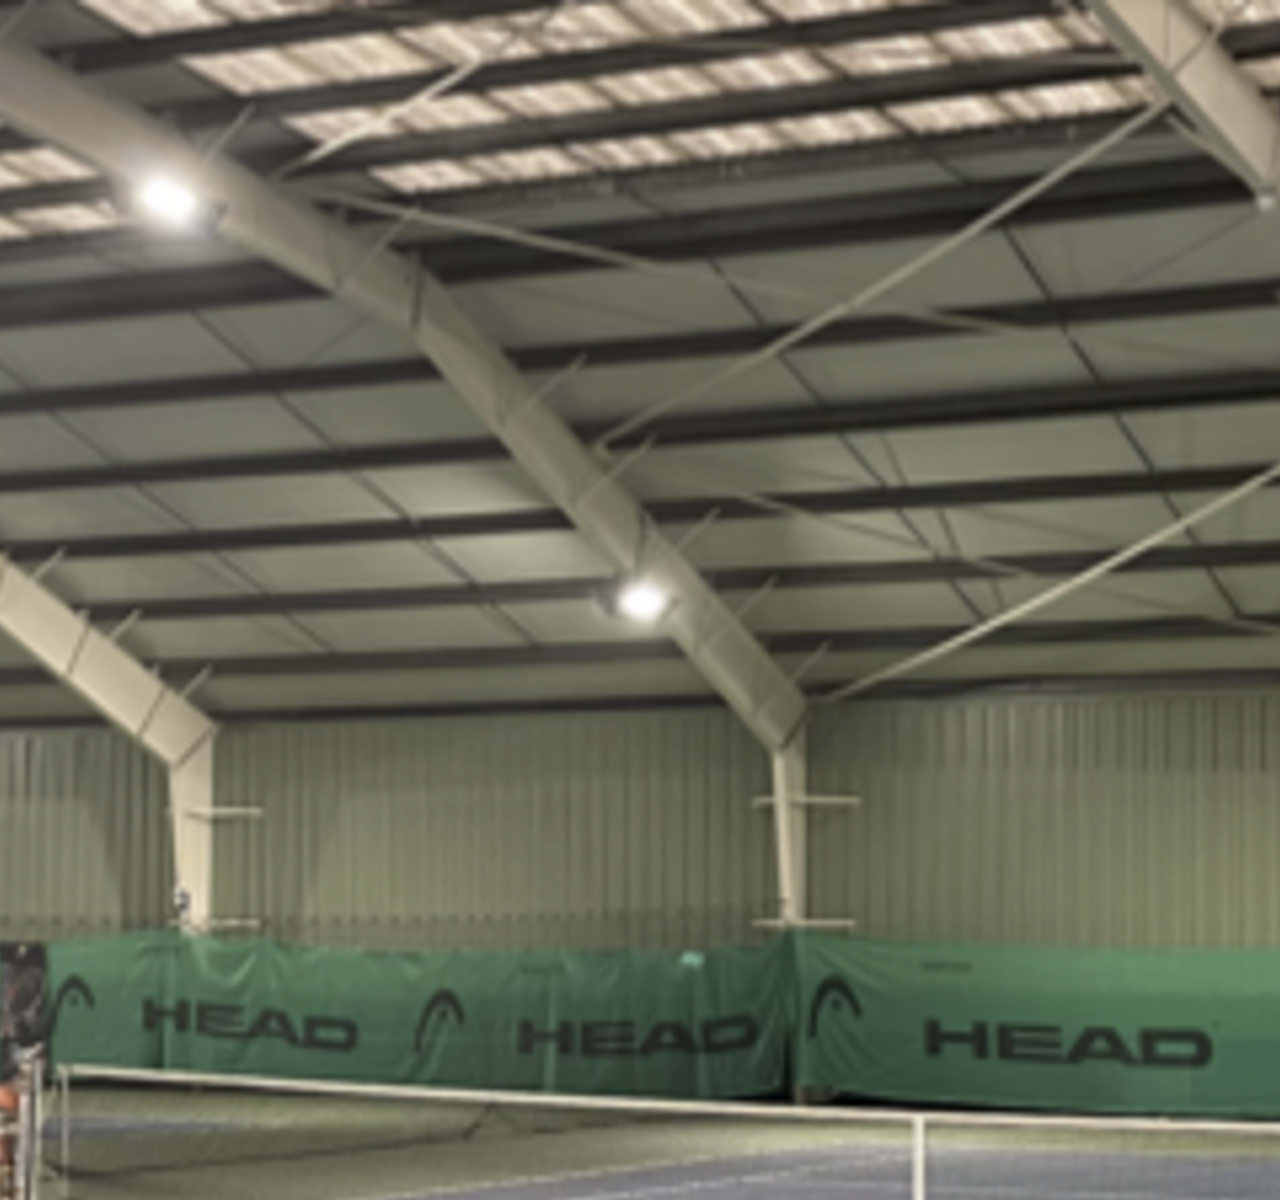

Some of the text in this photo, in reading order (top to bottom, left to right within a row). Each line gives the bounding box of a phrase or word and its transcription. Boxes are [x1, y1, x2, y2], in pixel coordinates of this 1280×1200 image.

[142, 999, 359, 1052] HEAD
[520, 1014, 759, 1056] HEAD
[925, 1019, 1213, 1067] HEAD
